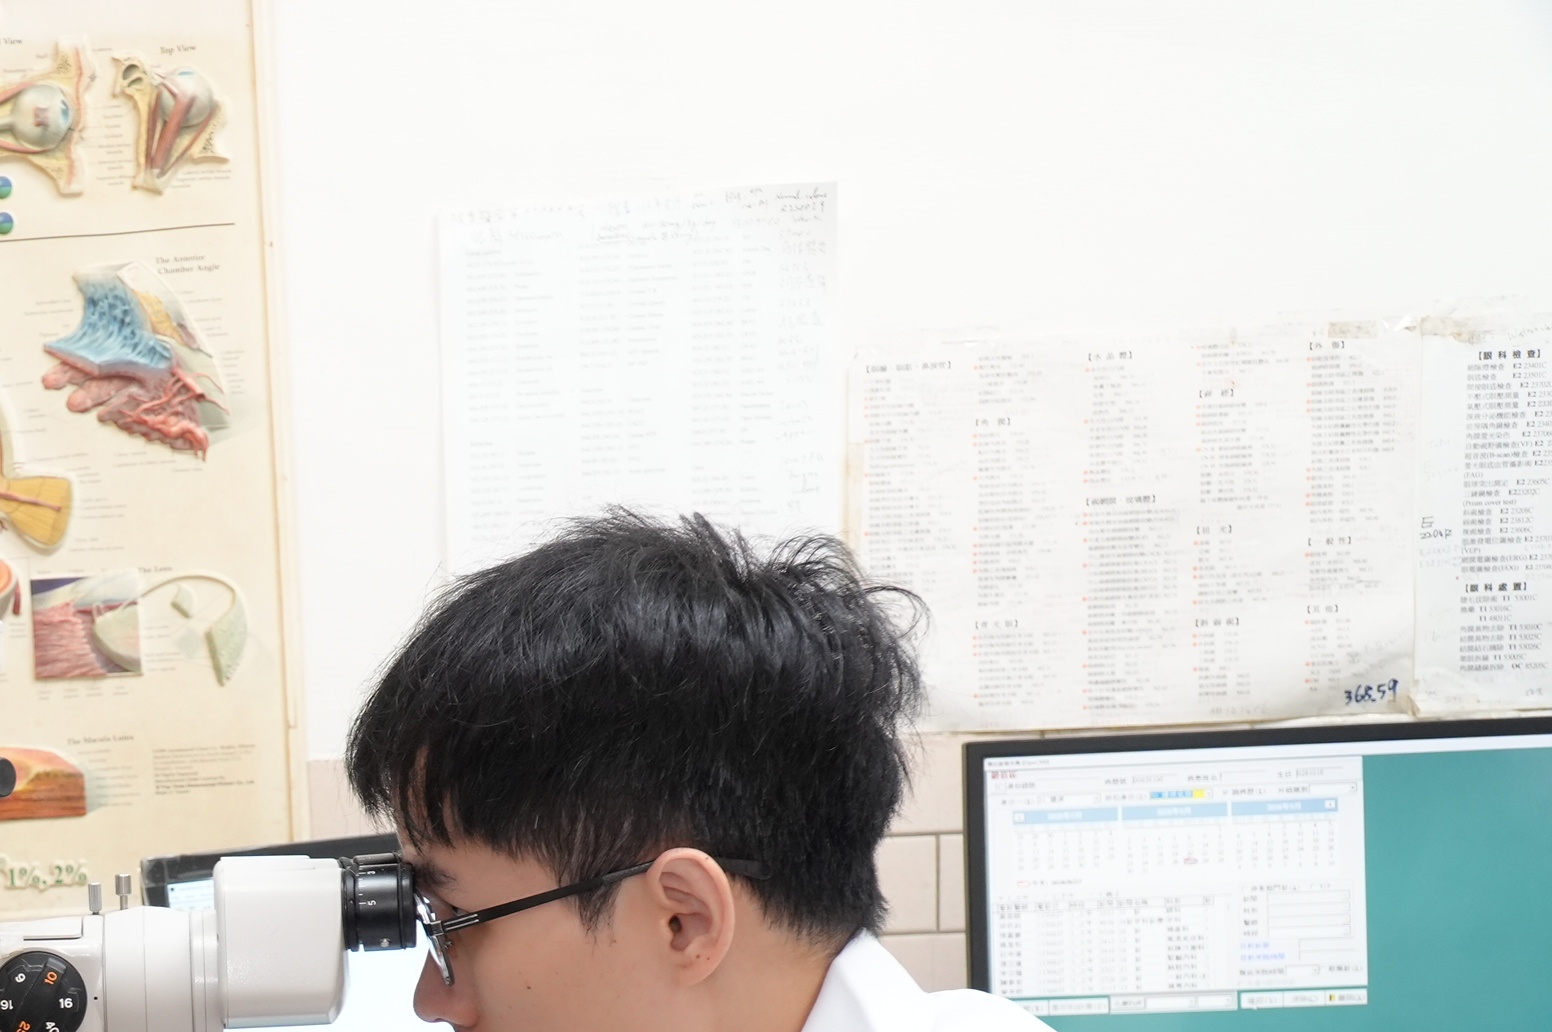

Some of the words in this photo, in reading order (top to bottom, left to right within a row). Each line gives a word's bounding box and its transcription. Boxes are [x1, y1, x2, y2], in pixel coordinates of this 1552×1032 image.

[54, 864, 88, 886] 2%
[44, 971, 58, 985] 10
[0, 999, 14, 1011] 16
[59, 997, 73, 1009] 16
